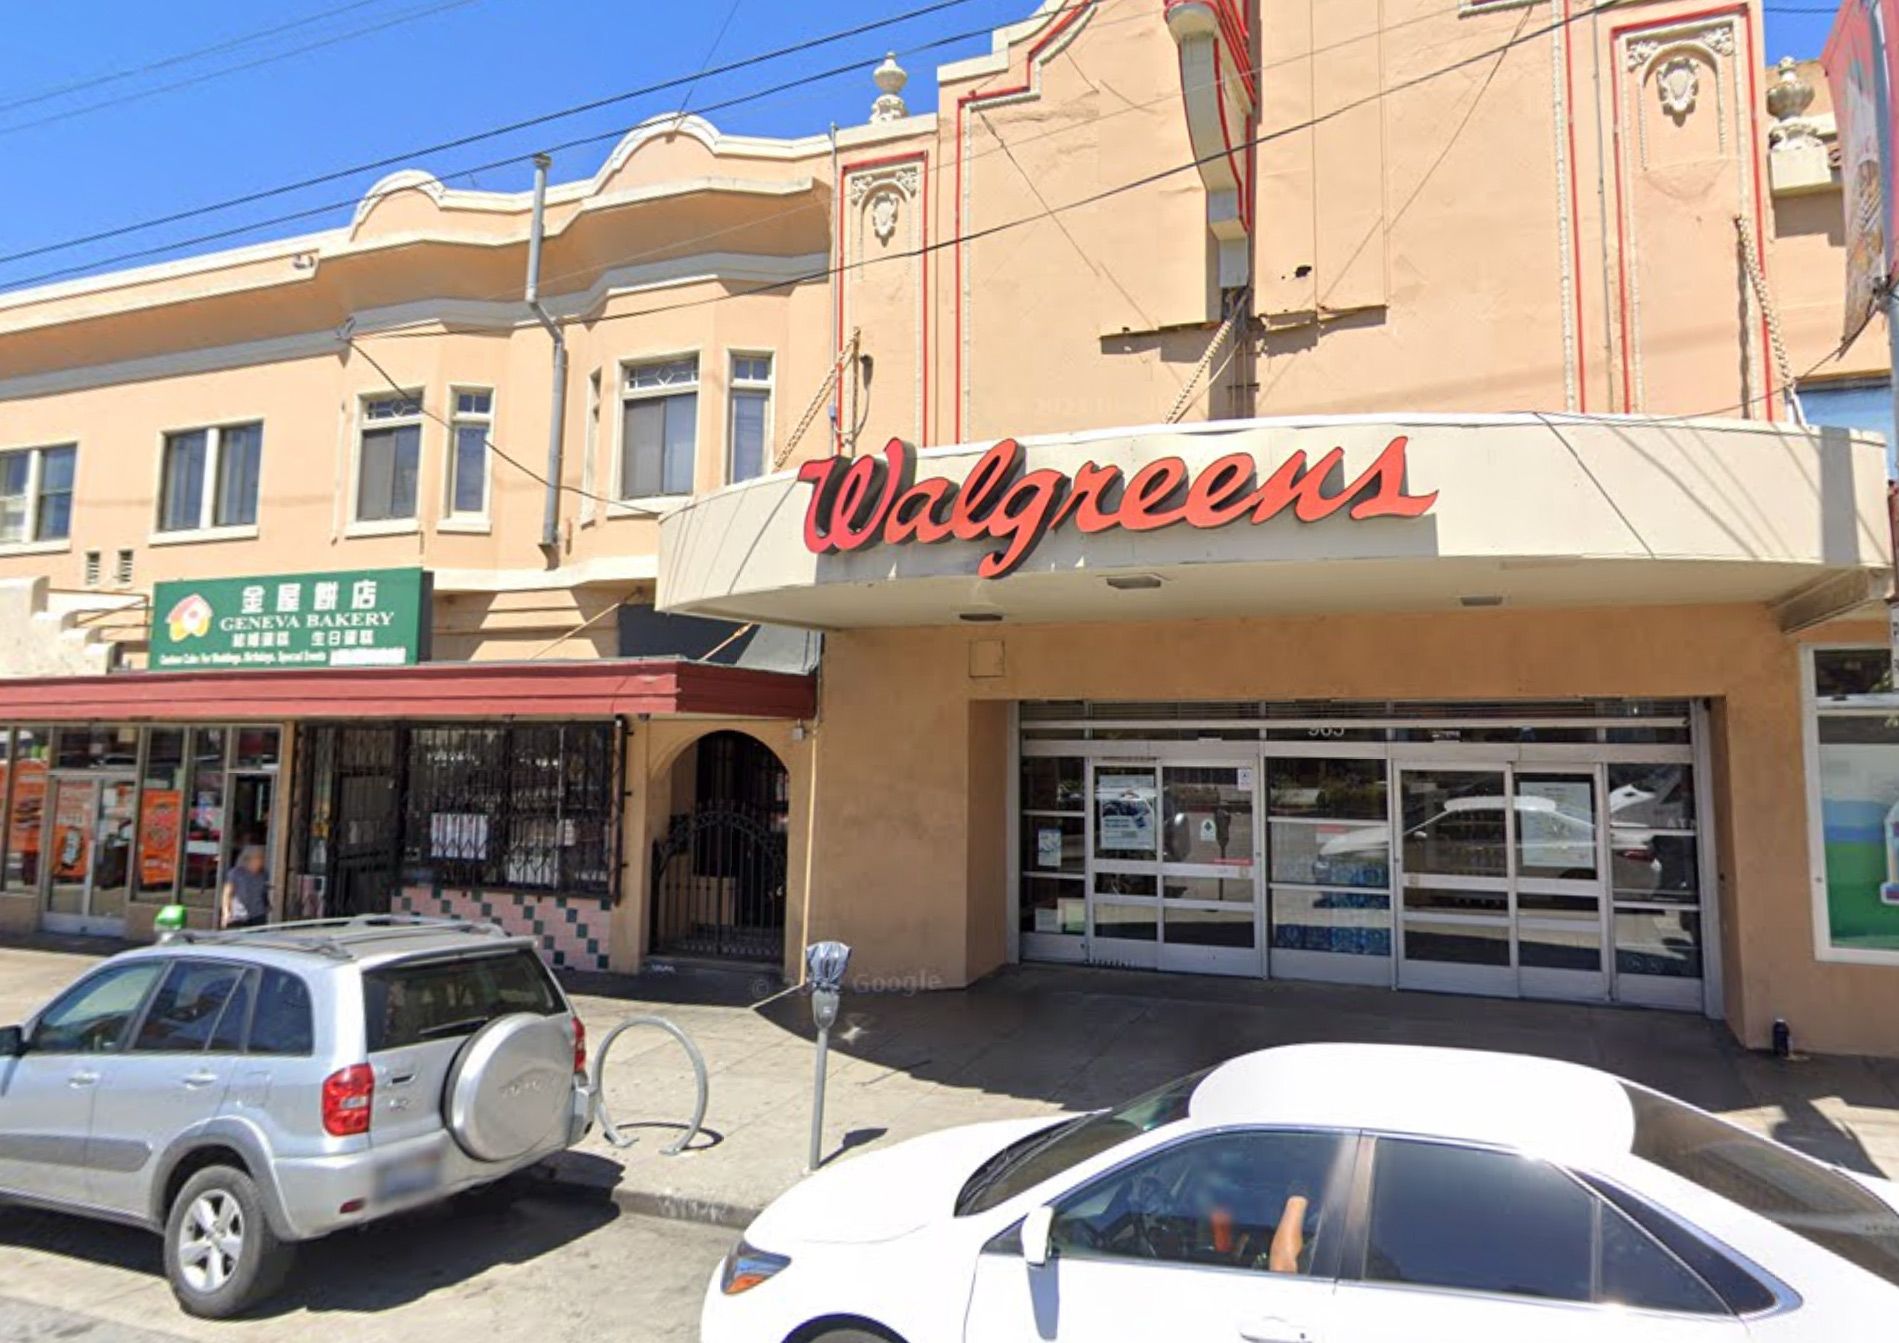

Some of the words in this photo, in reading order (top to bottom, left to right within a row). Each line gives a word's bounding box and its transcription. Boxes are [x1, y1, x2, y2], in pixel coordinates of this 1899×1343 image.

[798, 436, 1440, 579] Walgreens
[220, 614, 300, 631] GENEVA
[306, 611, 394, 628] BAKERY
